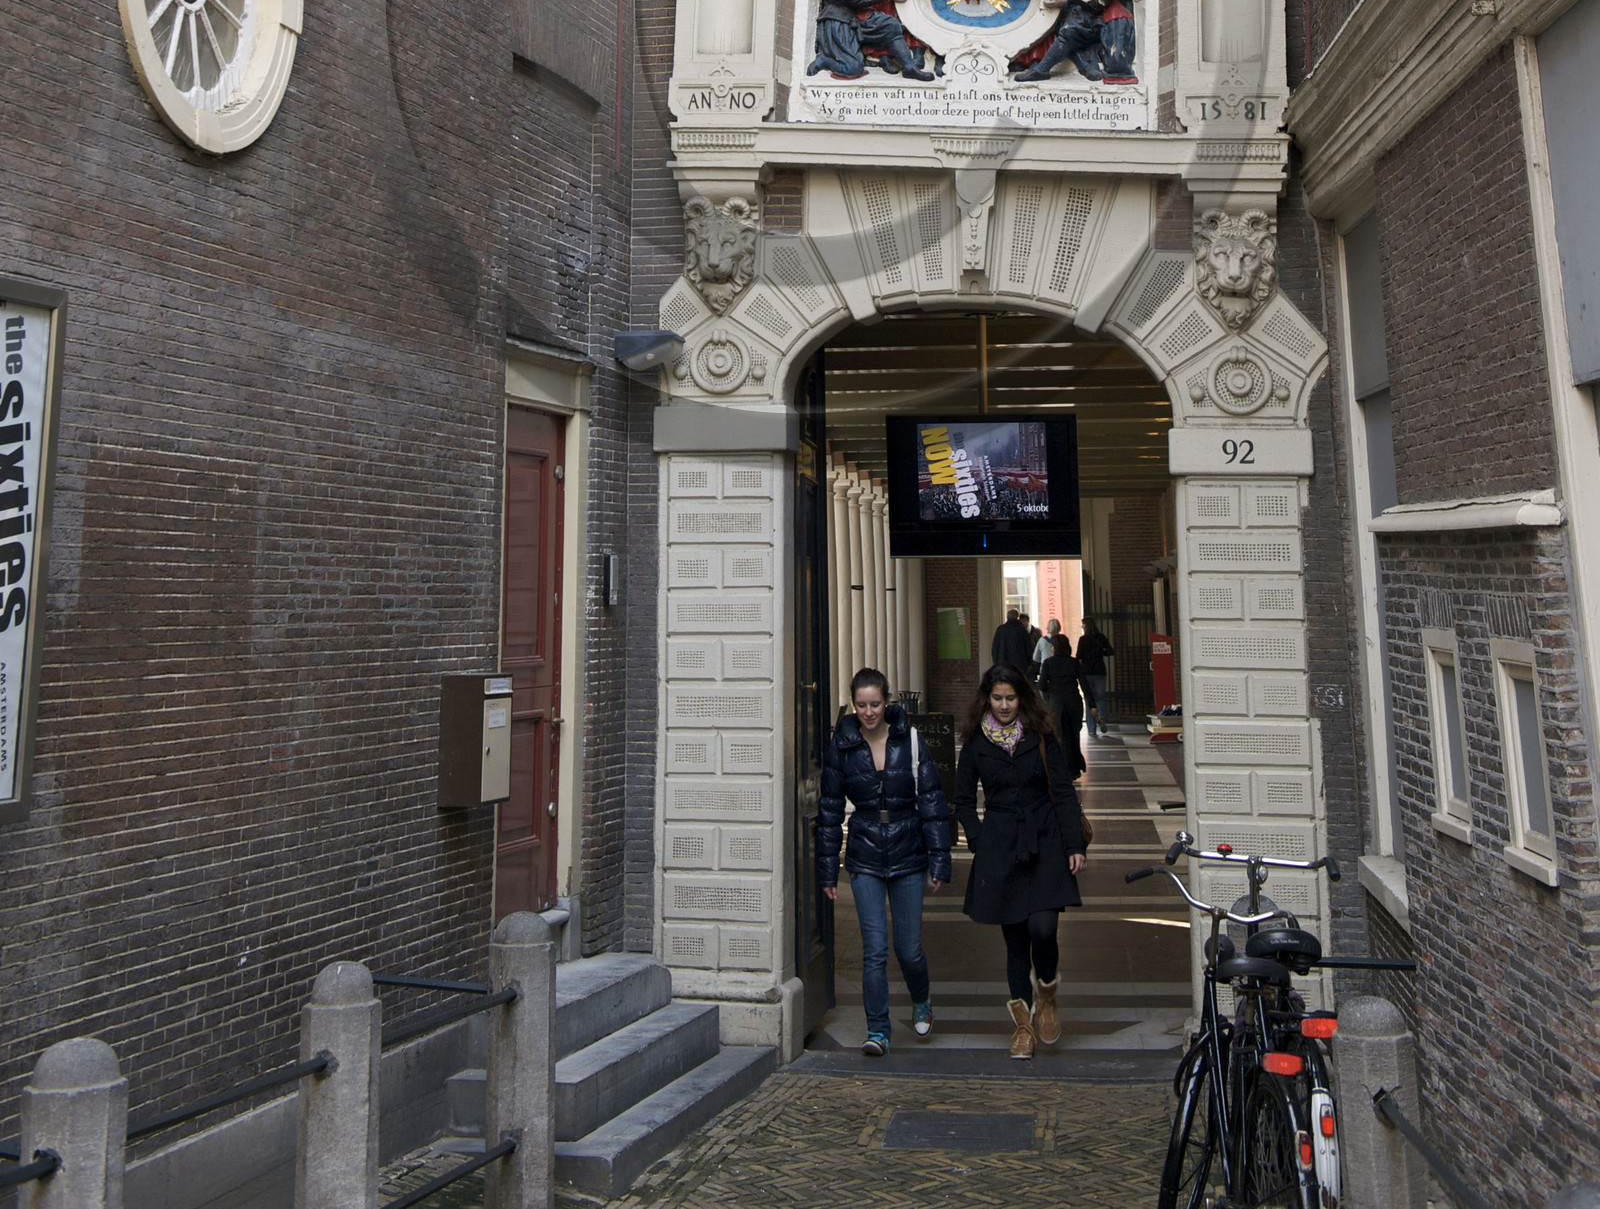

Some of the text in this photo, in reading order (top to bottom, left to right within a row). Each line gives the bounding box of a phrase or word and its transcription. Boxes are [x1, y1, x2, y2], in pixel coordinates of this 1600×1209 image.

[811, 89, 831, 103] Wy
[909, 91, 921, 99] in
[942, 92, 956, 101] en
[1005, 92, 1046, 103] tweede
[1048, 93, 1089, 104] Vaders
[838, 106, 852, 122] ga
[942, 102, 970, 117] deze
[1017, 107, 1041, 125] help
[1042, 110, 1061, 121] een
[1091, 106, 1129, 128] dragen
[5, 315, 26, 375] the
[921, 426, 959, 485] NOW
[1222, 438, 1255, 465] 92
[949, 448, 980, 519] sixties
[1047, 577, 1057, 619] Museu
